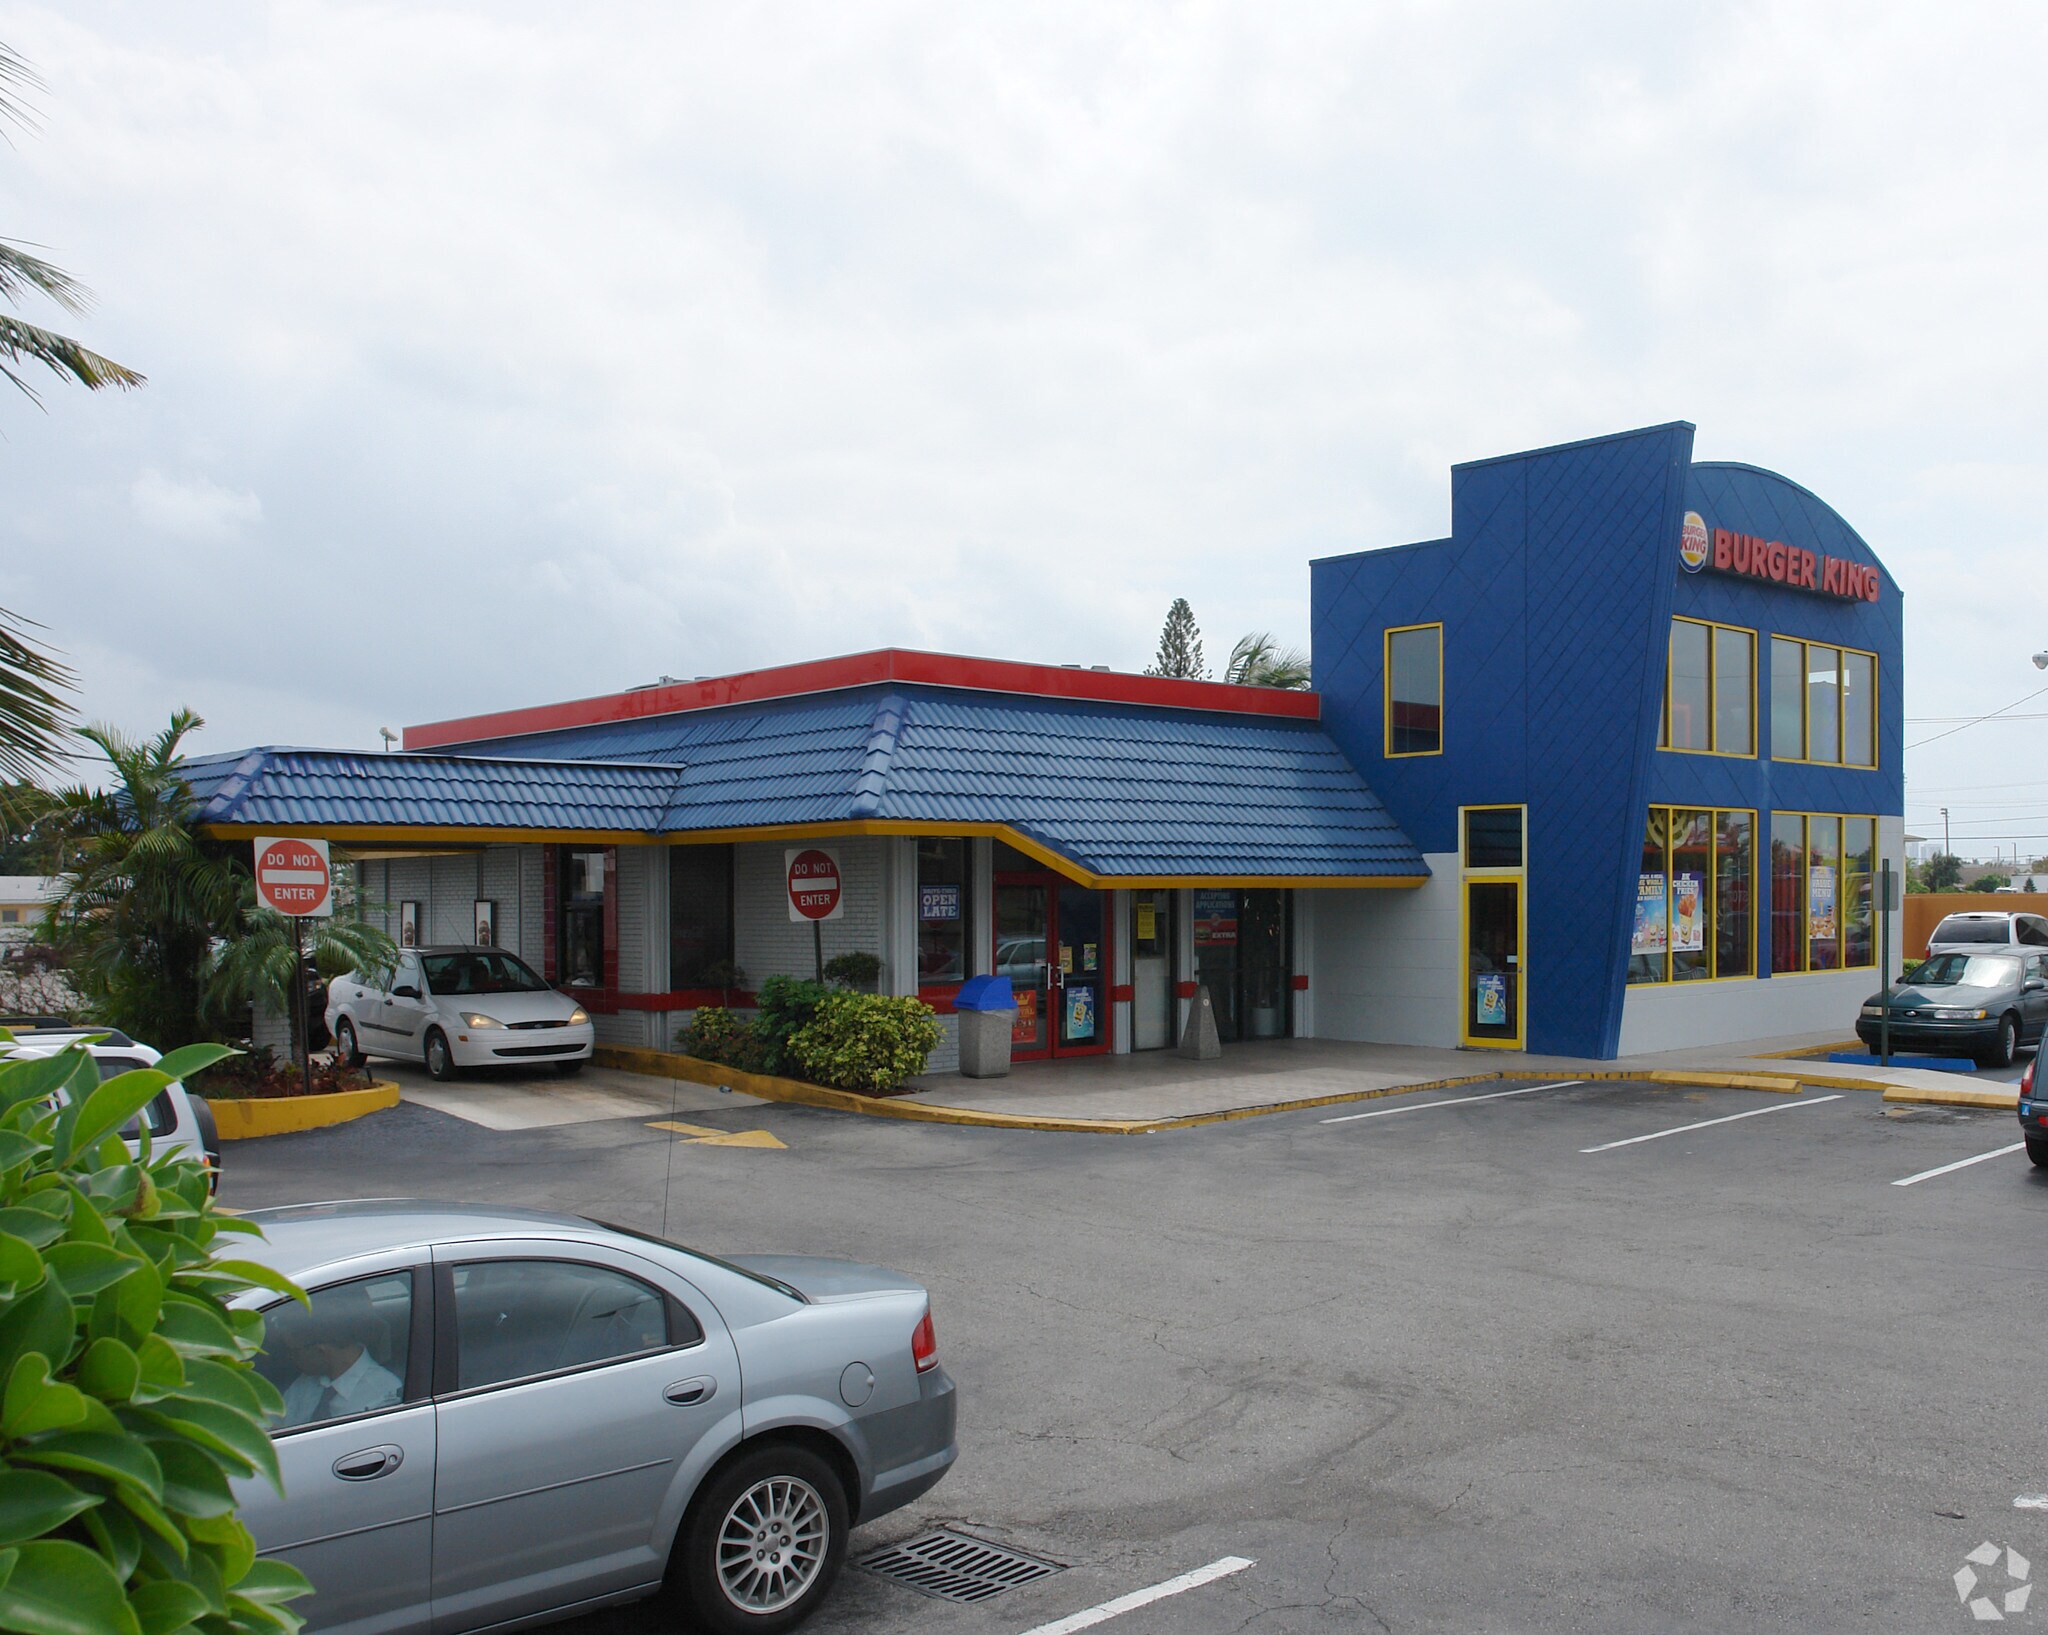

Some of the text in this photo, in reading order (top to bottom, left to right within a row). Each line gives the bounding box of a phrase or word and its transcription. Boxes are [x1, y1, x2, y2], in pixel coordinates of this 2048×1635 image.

[1682, 525, 1706, 538] BURGER
[1681, 537, 1706, 554] KING
[1713, 528, 1880, 603] BURGER KING
[267, 854, 318, 867] DO NOT
[794, 862, 832, 875] DO NOT
[274, 888, 315, 900] ENTER
[800, 894, 831, 906] ENTER
[923, 895, 957, 906] OPEN
[923, 906, 957, 917] LATE
